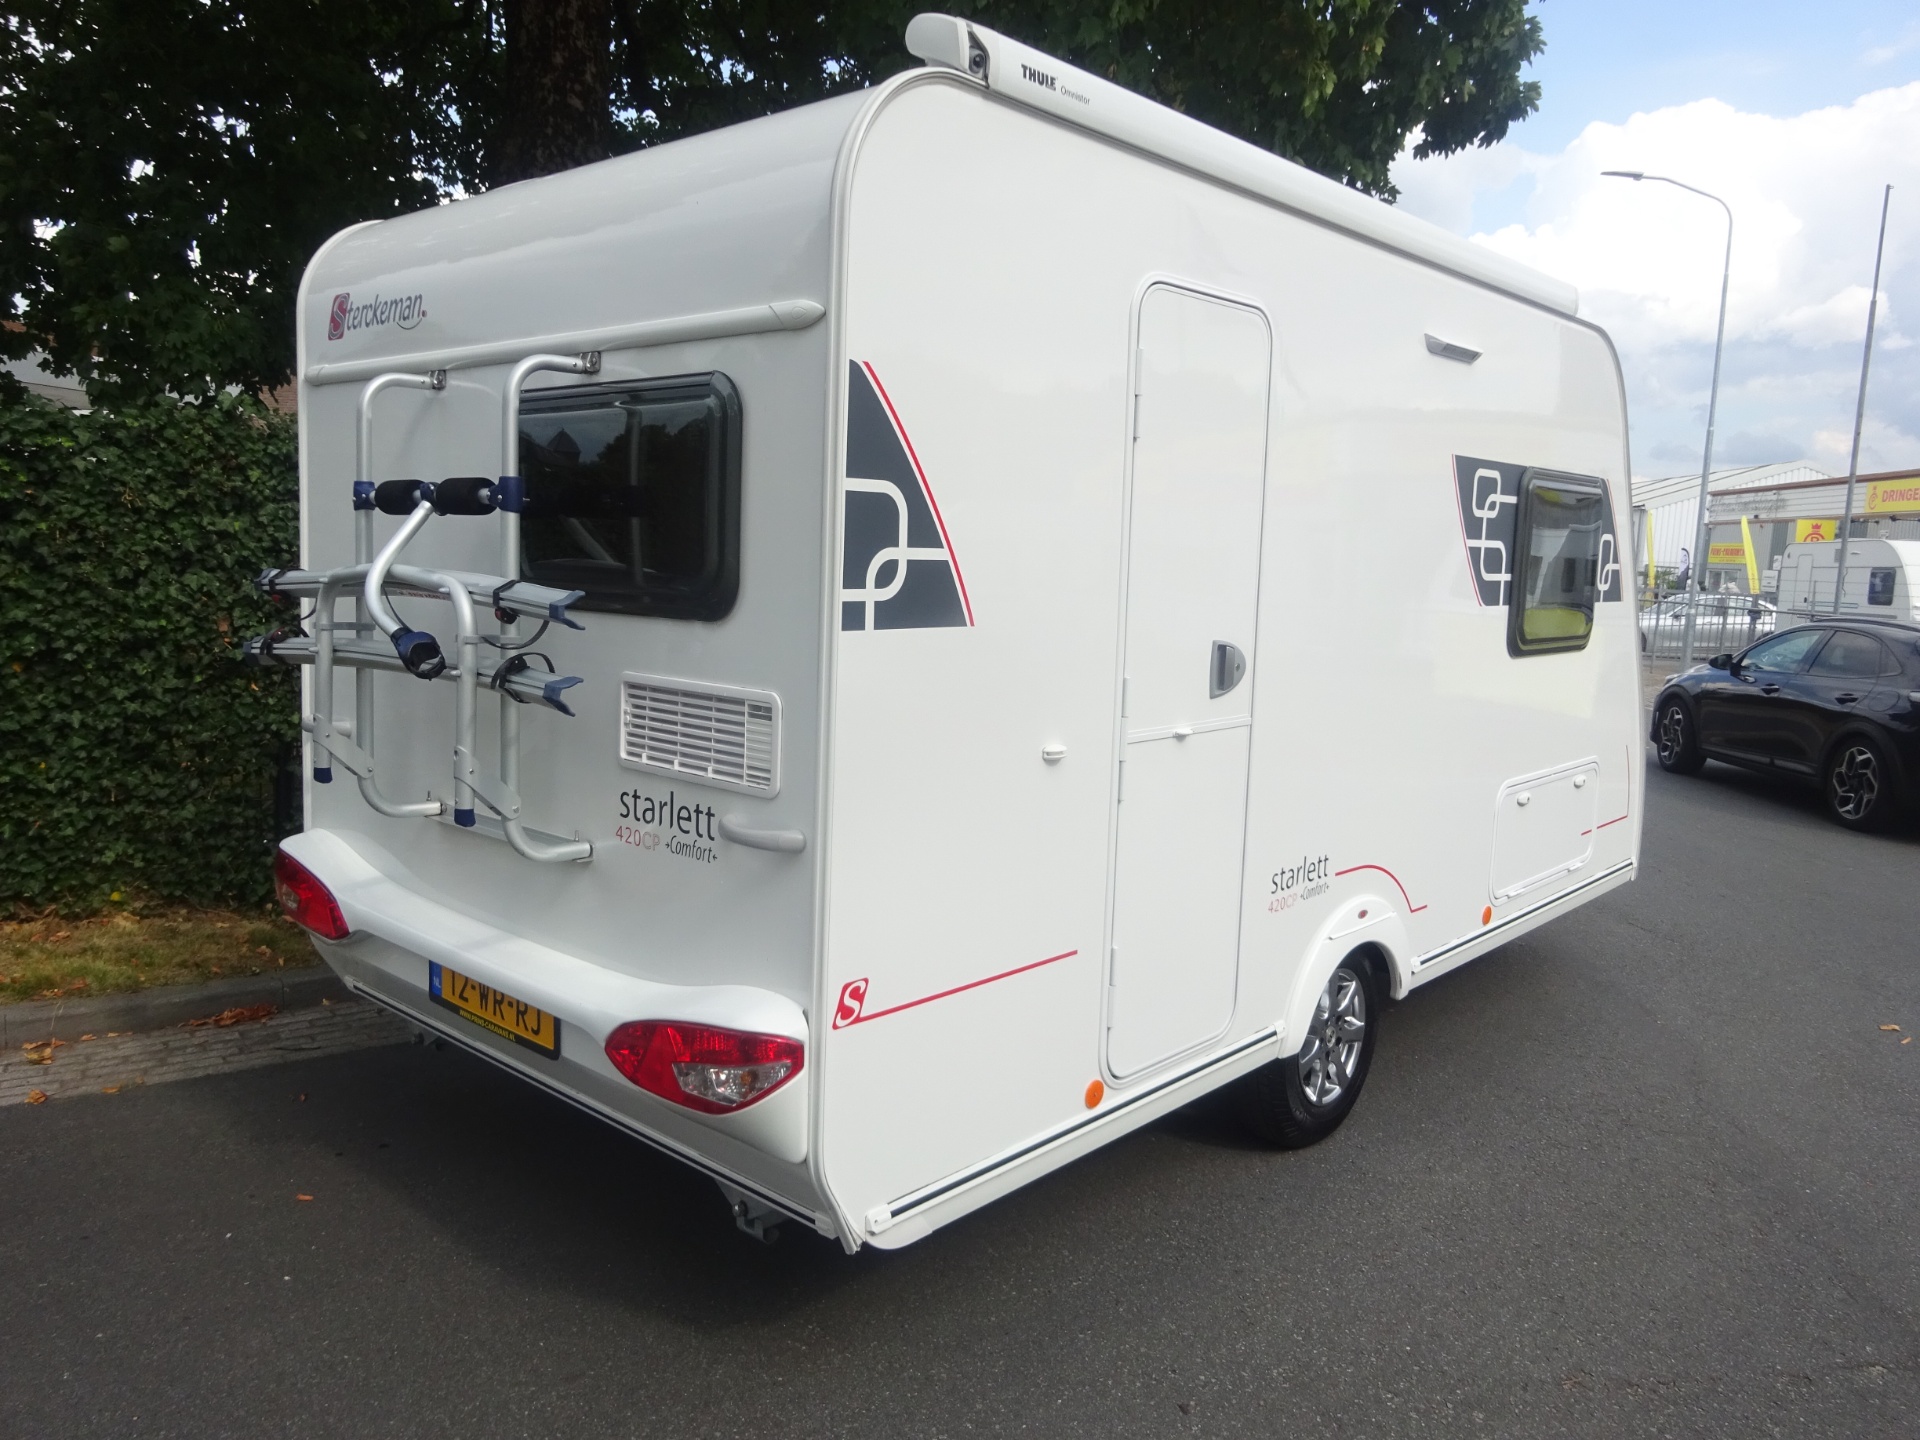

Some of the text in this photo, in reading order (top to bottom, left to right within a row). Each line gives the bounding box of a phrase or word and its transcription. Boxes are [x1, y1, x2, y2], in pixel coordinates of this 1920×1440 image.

[1021, 63, 1090, 106] THULE Omnistor
[620, 789, 715, 841] starlett
[615, 825, 660, 851] 420CP
[1271, 854, 1329, 894] starlett
[1268, 893, 1297, 913] 420CP
